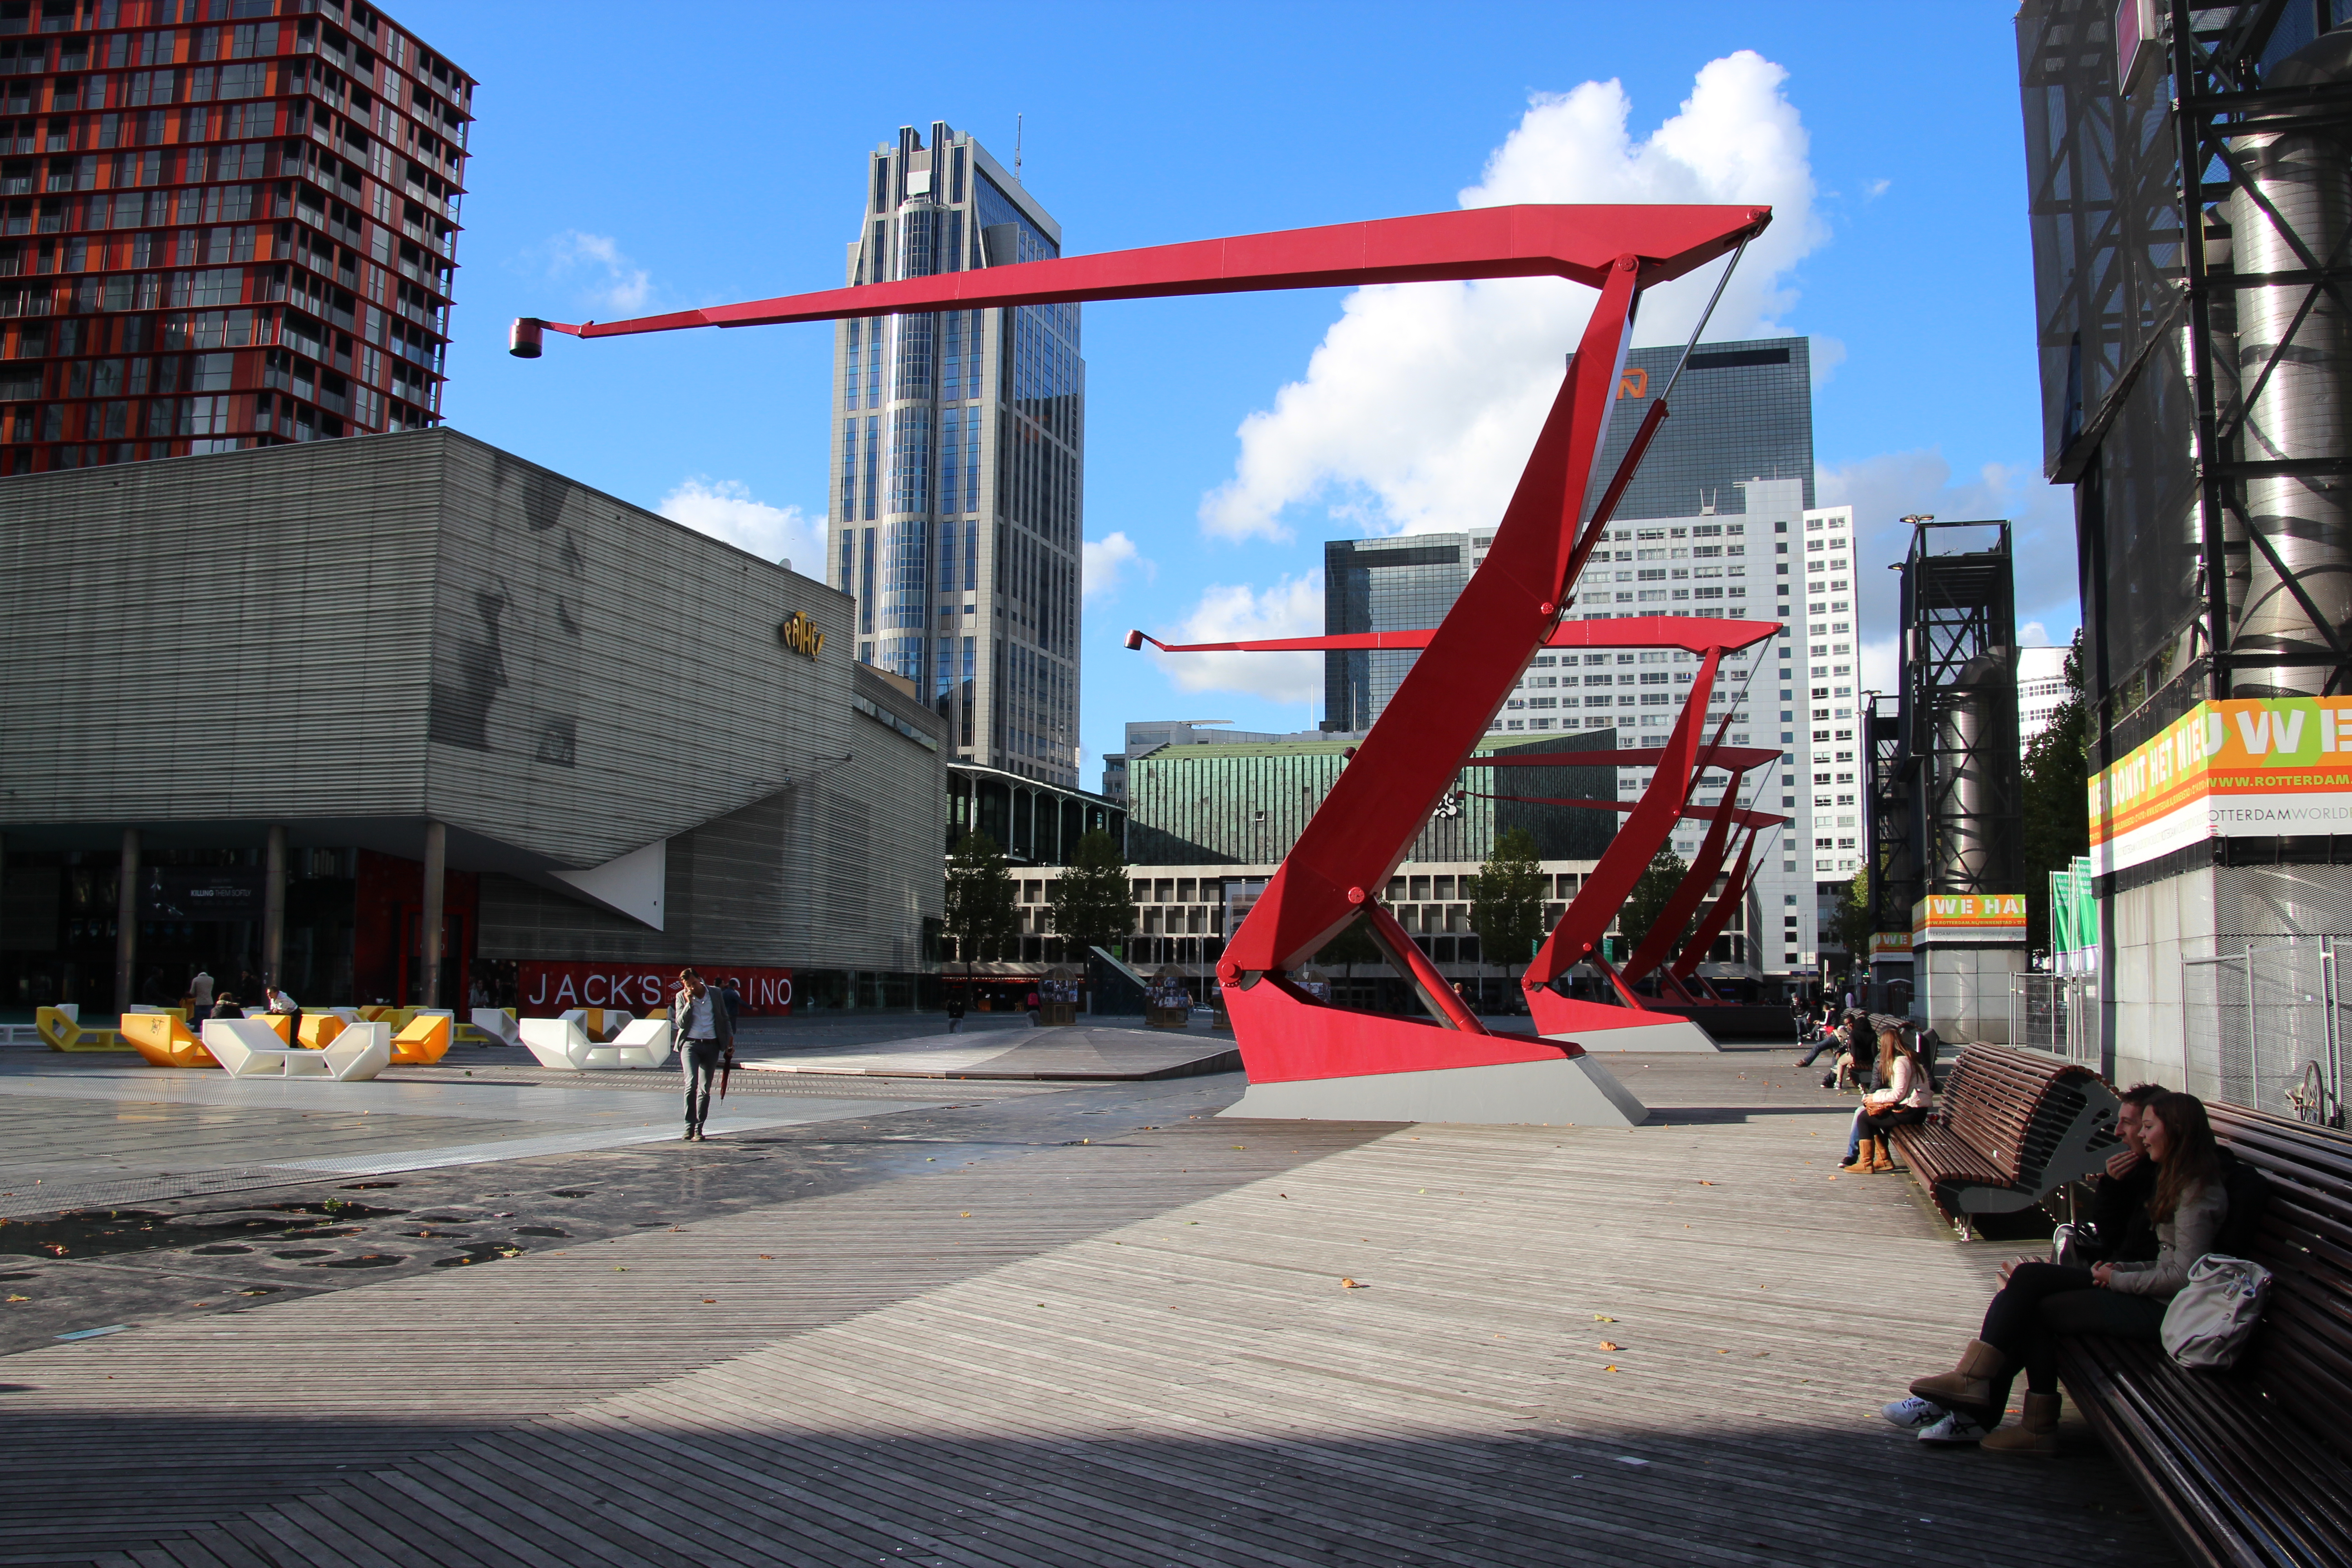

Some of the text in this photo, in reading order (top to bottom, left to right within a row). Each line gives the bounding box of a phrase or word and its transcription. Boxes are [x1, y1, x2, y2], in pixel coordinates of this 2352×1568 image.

[2111, 755, 2146, 807] BONKT
[2150, 737, 2174, 787] HET
[1930, 899, 1973, 914] WE
[529, 974, 661, 1004] JACK'S
